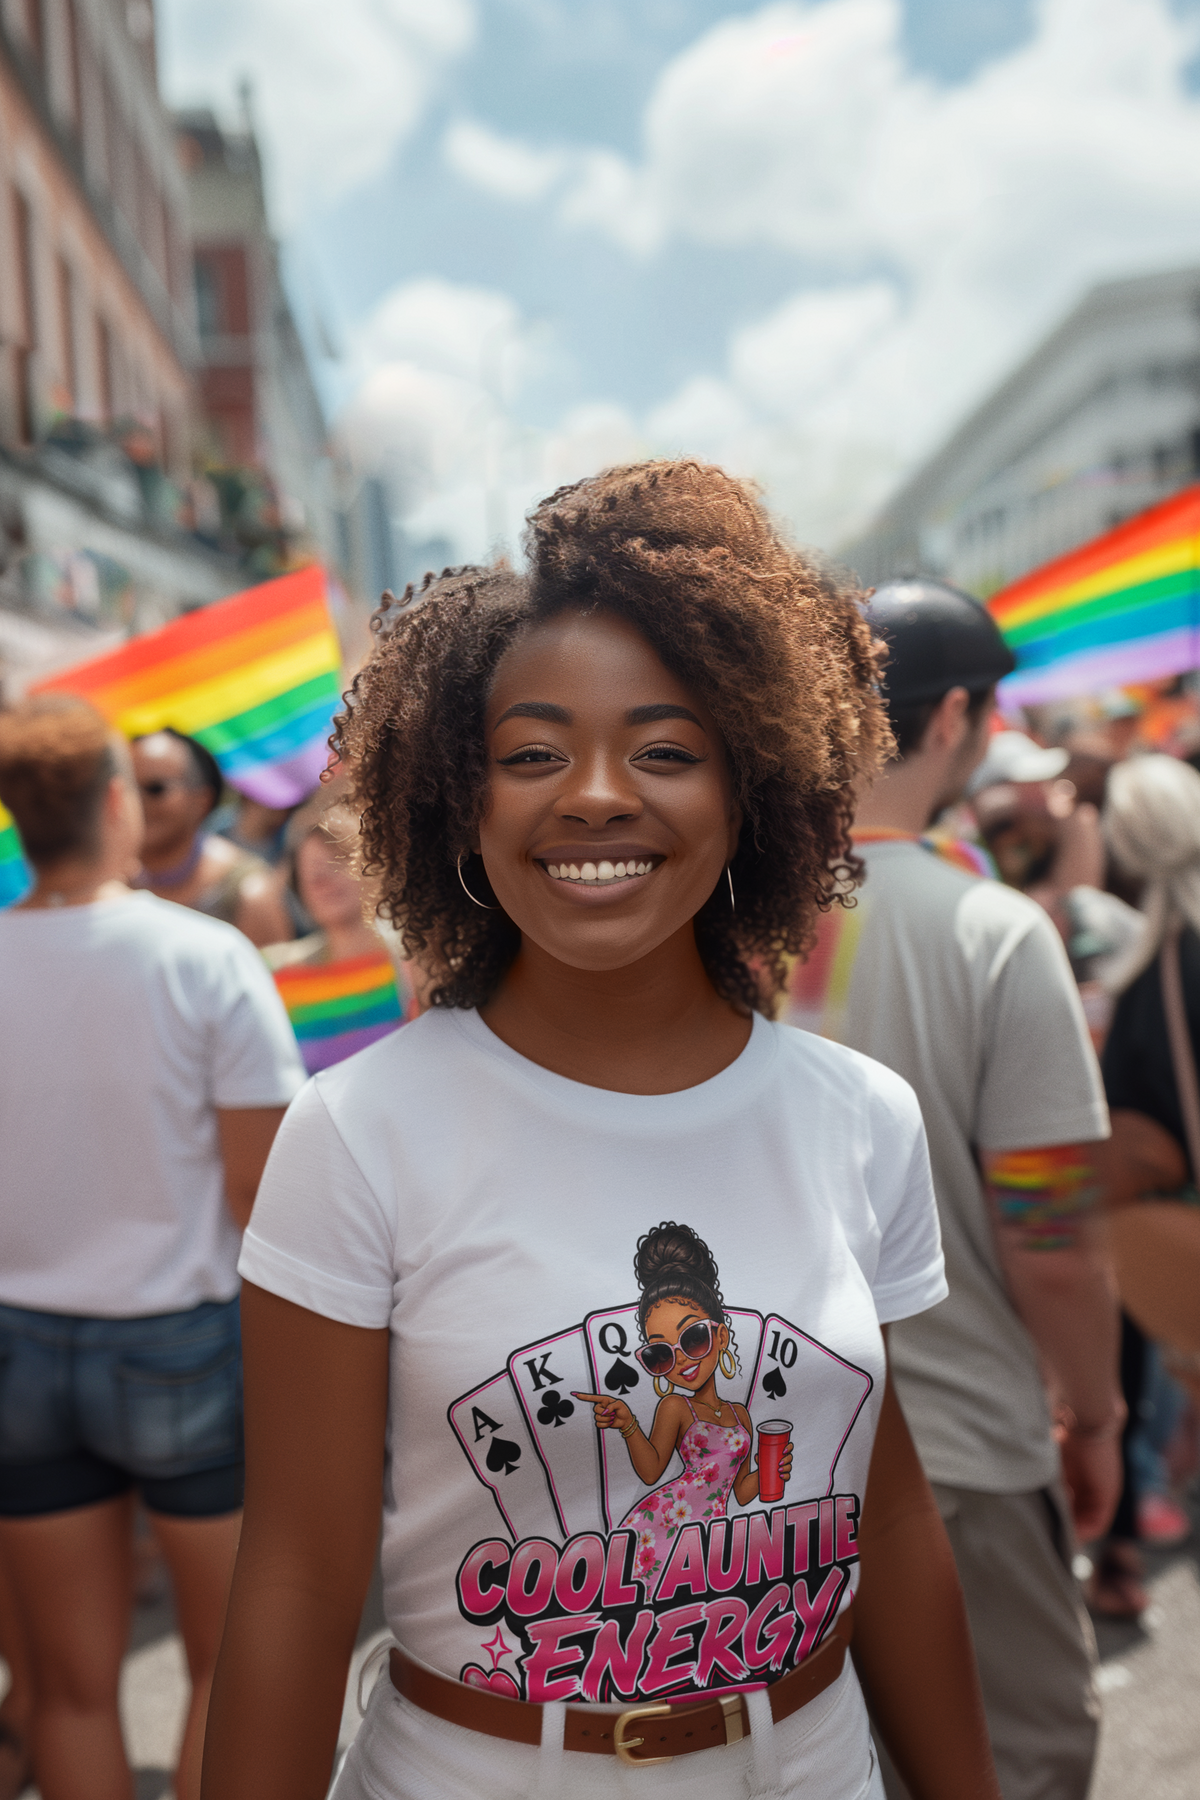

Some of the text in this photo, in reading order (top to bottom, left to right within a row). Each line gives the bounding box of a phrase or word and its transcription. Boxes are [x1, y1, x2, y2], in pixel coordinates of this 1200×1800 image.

[598, 1322, 632, 1356] Q
[766, 1330, 799, 1369] 10
[523, 1352, 564, 1391] K
[468, 1405, 503, 1442] A
[459, 1498, 859, 1616] COOL AUNTIE
[525, 1566, 844, 1701] ENERGY
